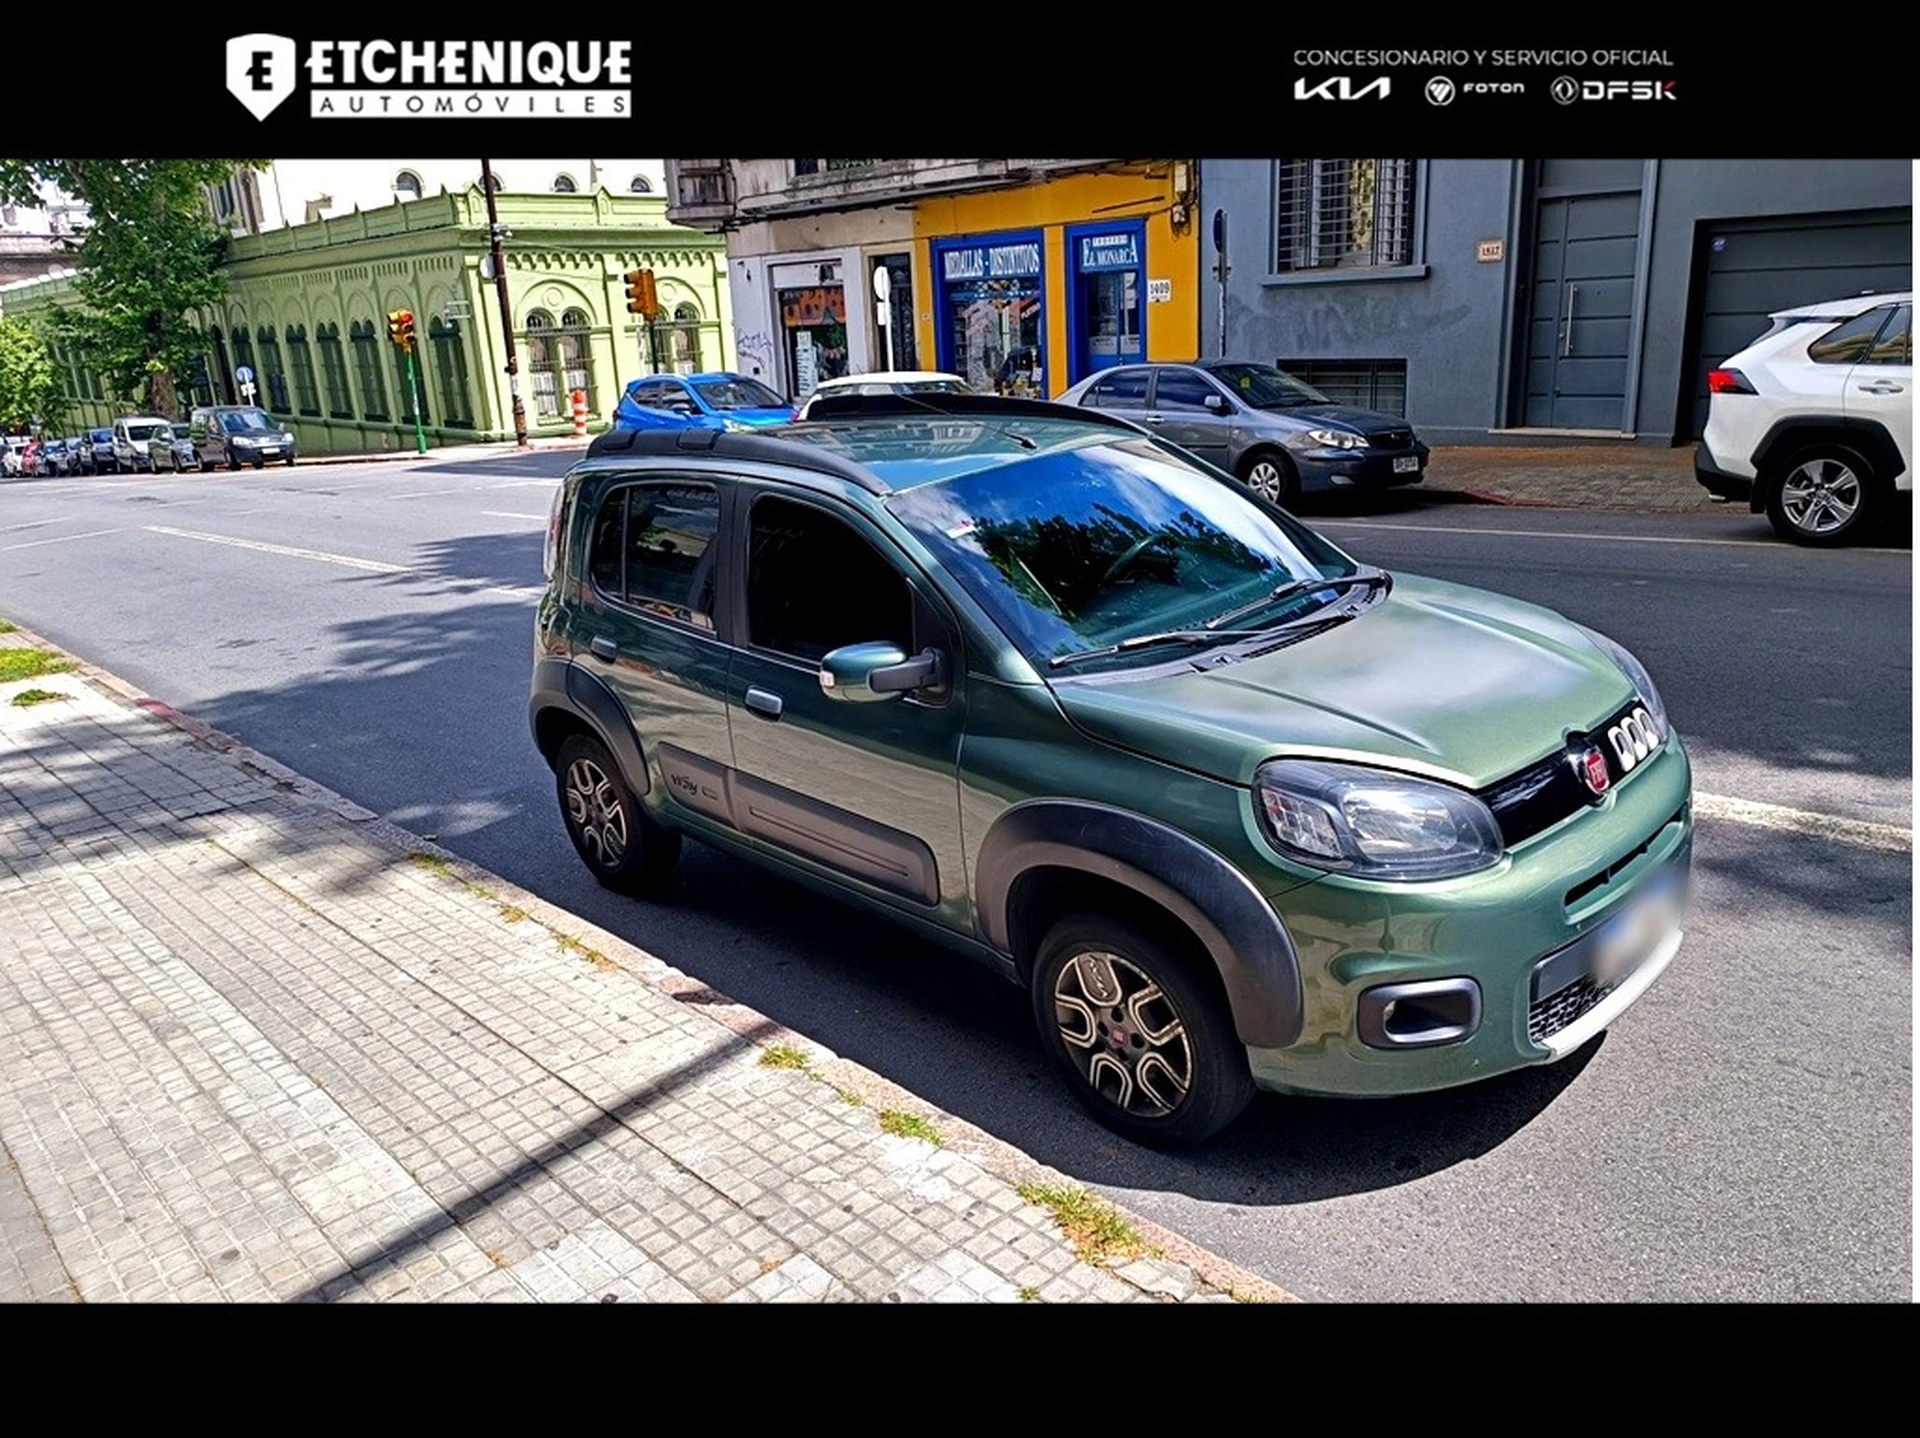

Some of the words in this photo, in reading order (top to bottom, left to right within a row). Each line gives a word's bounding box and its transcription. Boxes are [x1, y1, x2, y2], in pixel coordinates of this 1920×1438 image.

[944, 248, 984, 279] MEDALLAS
[989, 243, 1040, 275] DISTINTIVOS
[1097, 234, 1139, 266] MONARCA
